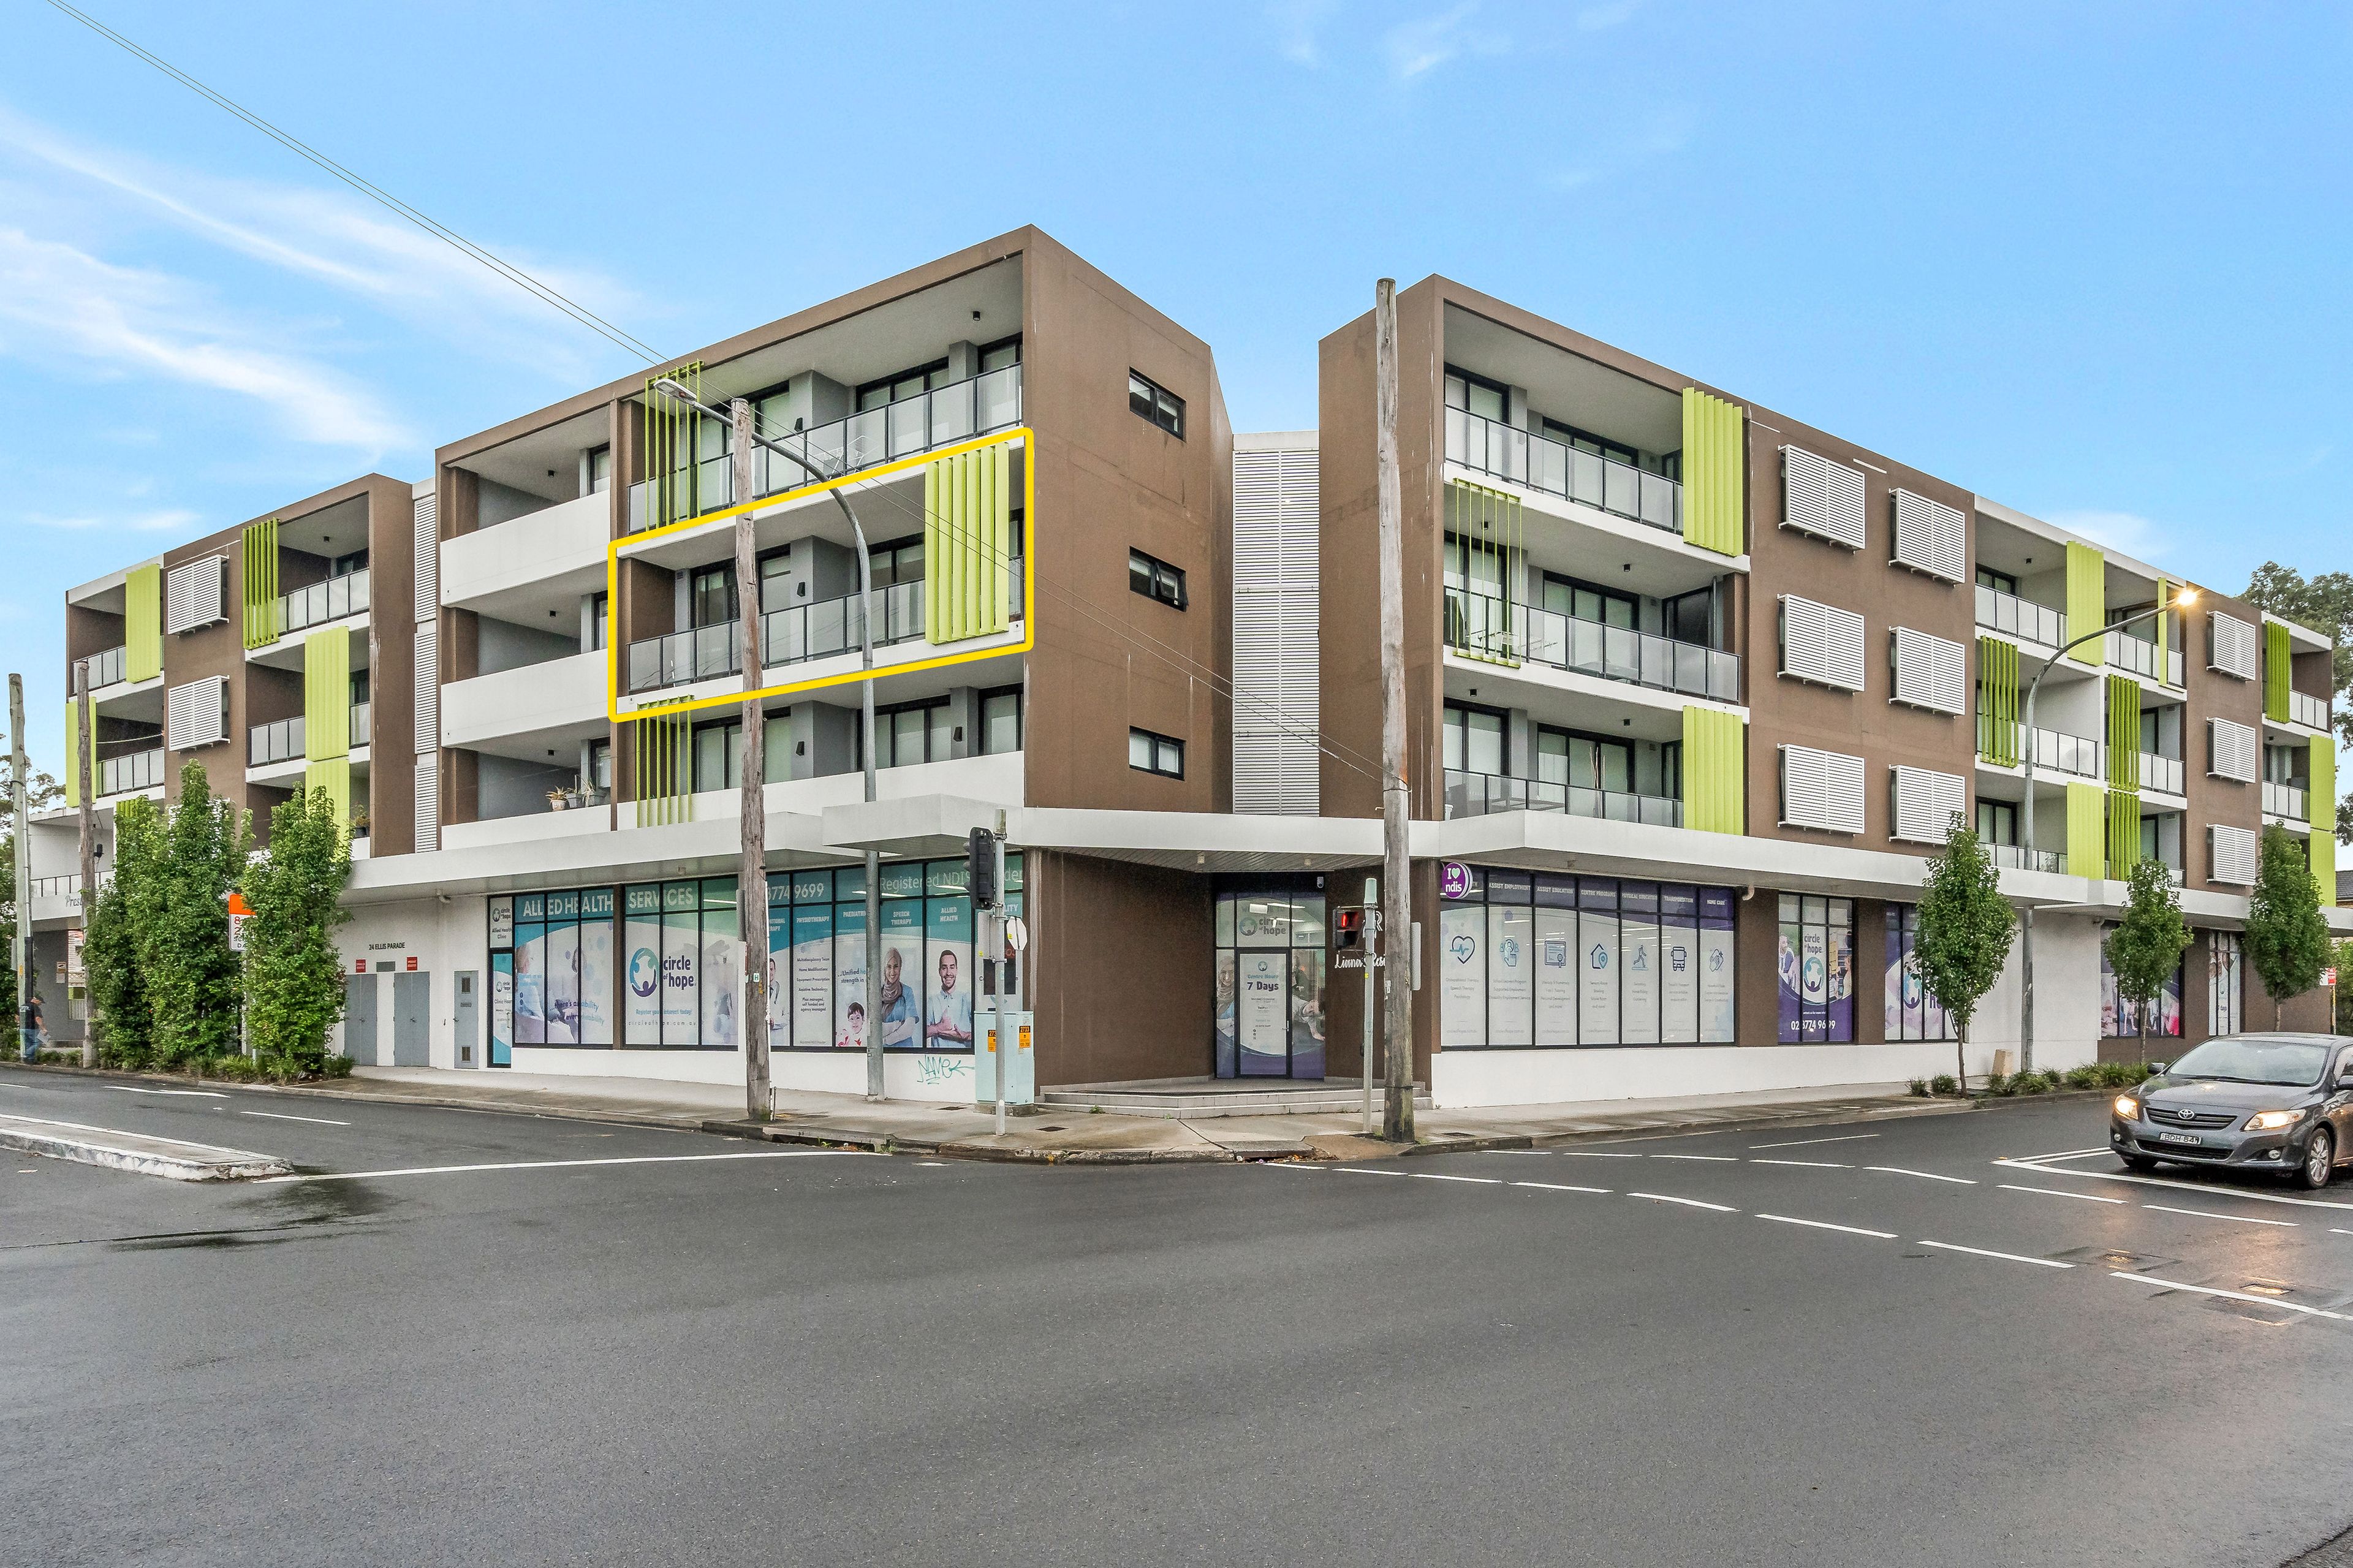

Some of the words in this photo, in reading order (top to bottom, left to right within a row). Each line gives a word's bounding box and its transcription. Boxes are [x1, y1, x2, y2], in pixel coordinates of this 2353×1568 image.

[1447, 868, 1452, 879] I
[794, 882, 824, 899] 9699
[1446, 881, 1462, 892] ndis
[629, 887, 694, 909] SERVICES
[523, 899, 563, 917] ALLED
[564, 895, 613, 914] HEALTH
[1264, 926, 1286, 936] hope
[1805, 933, 1820, 943] circle
[1807, 944, 1822, 955] hope
[663, 955, 691, 971] circle
[669, 972, 694, 990] hope
[1247, 982, 1253, 990] 7
[1257, 981, 1279, 991] Days
[1791, 1021, 1800, 1030] 02
